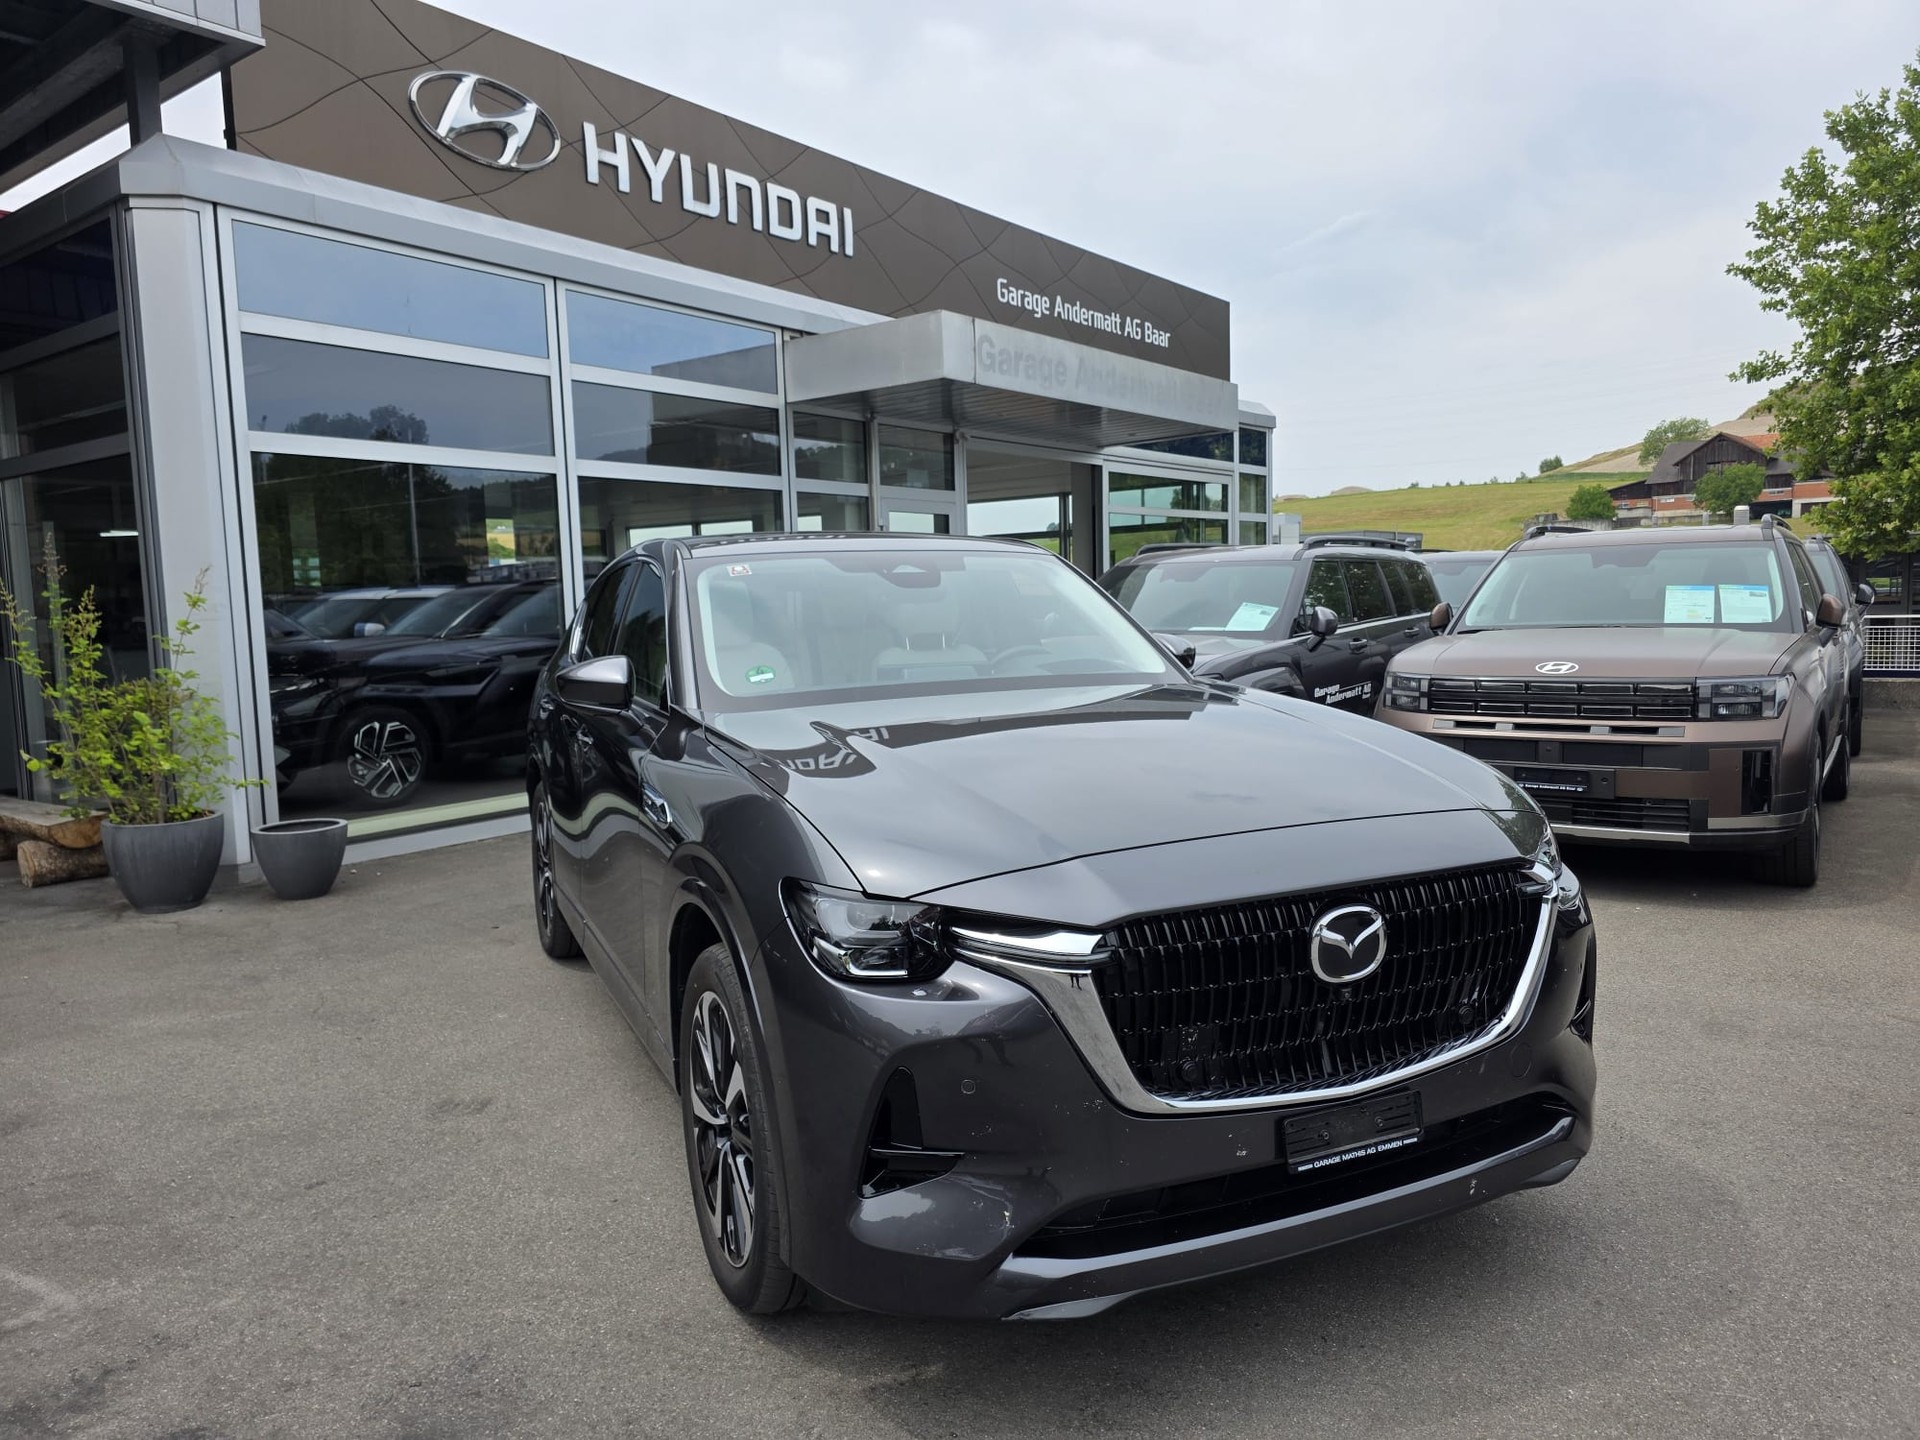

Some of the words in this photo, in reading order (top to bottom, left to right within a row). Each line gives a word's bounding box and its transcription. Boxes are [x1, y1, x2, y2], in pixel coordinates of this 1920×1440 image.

[582, 120, 854, 258] HYUNDAI
[996, 277, 1050, 319] Garage
[1054, 294, 1122, 336] Andermatt
[1124, 317, 1142, 341] AG
[1144, 320, 1171, 349] Baar
[976, 333, 1067, 390] Garage
[1314, 684, 1340, 698] Garage
[1325, 686, 1362, 704] Andermatt
[1314, 1155, 1341, 1168] GARAGE
[1342, 1150, 1366, 1161] MATHIS
[1366, 1147, 1376, 1155] AG
[1378, 1140, 1402, 1152] EMMEN
